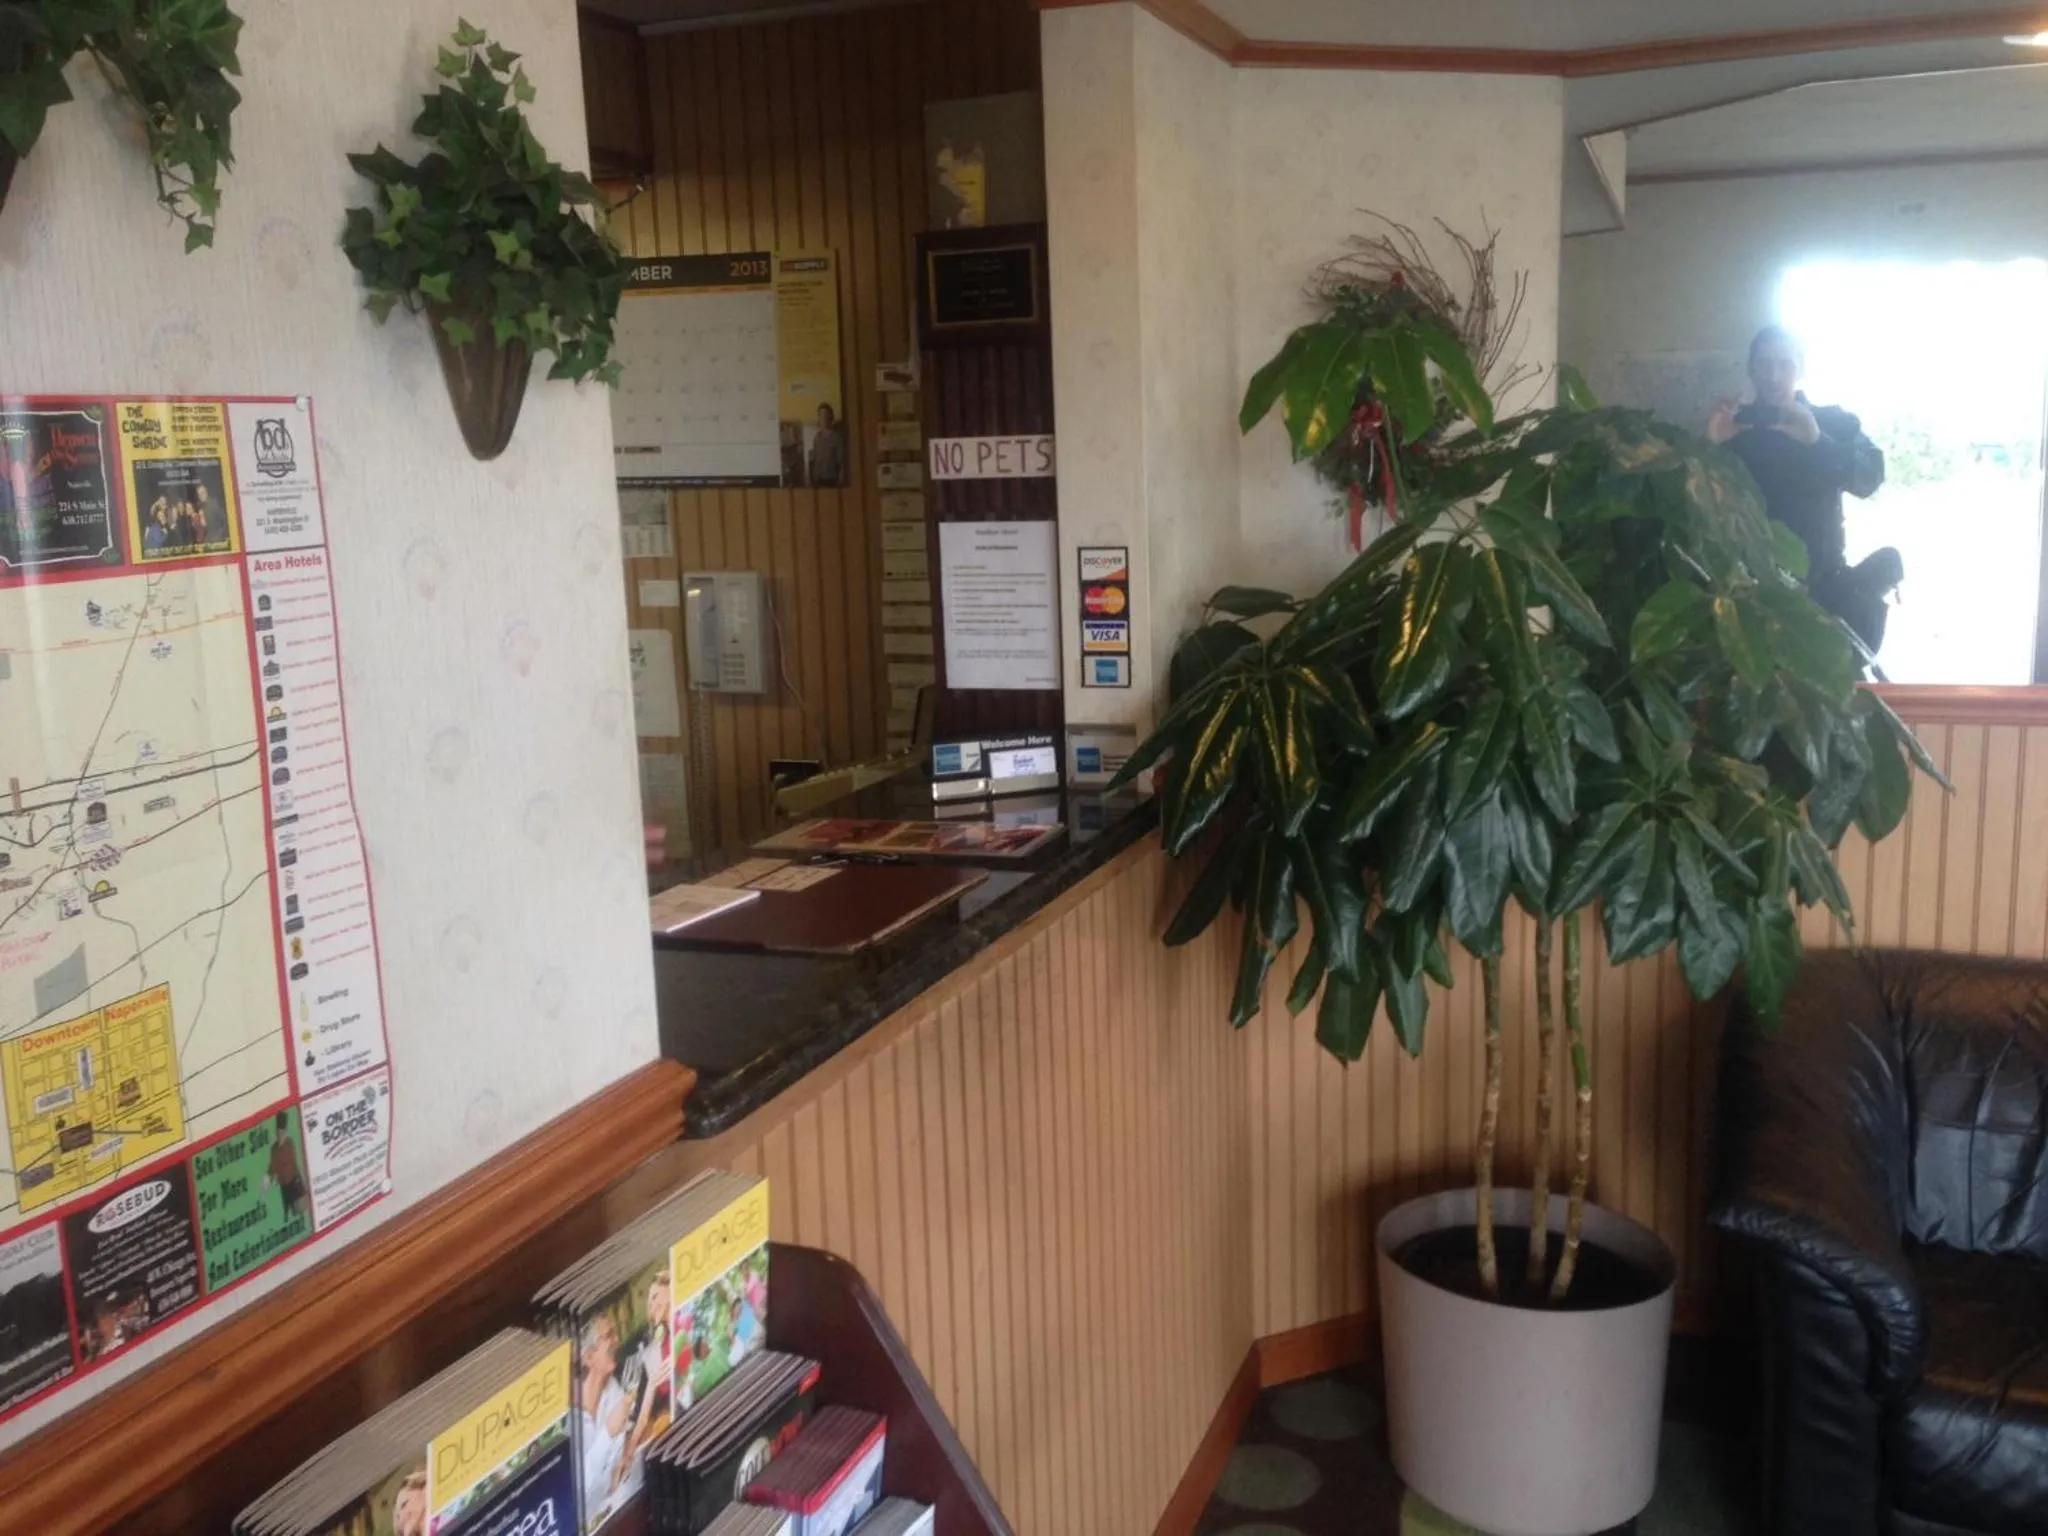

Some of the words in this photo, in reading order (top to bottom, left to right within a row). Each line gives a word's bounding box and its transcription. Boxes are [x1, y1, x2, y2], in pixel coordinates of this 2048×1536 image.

[730, 260, 768, 277] 2013
[934, 441, 964, 475] NO
[976, 438, 1053, 474] PETS
[254, 558, 282, 572] Area
[285, 554, 322, 568] Hotels
[1091, 630, 1120, 641] VISA
[981, 738, 1025, 750] Welcome
[1027, 735, 1052, 745] Here
[22, 1017, 98, 1053] Downtown
[321, 1108, 378, 1145] BORDER
[326, 1110, 343, 1127] ON
[345, 1099, 367, 1117] THE
[195, 1156, 214, 1180] See
[249, 1126, 270, 1154] Side
[676, 1197, 761, 1284] DUPAGE
[437, 1365, 556, 1485] DUPAGE
